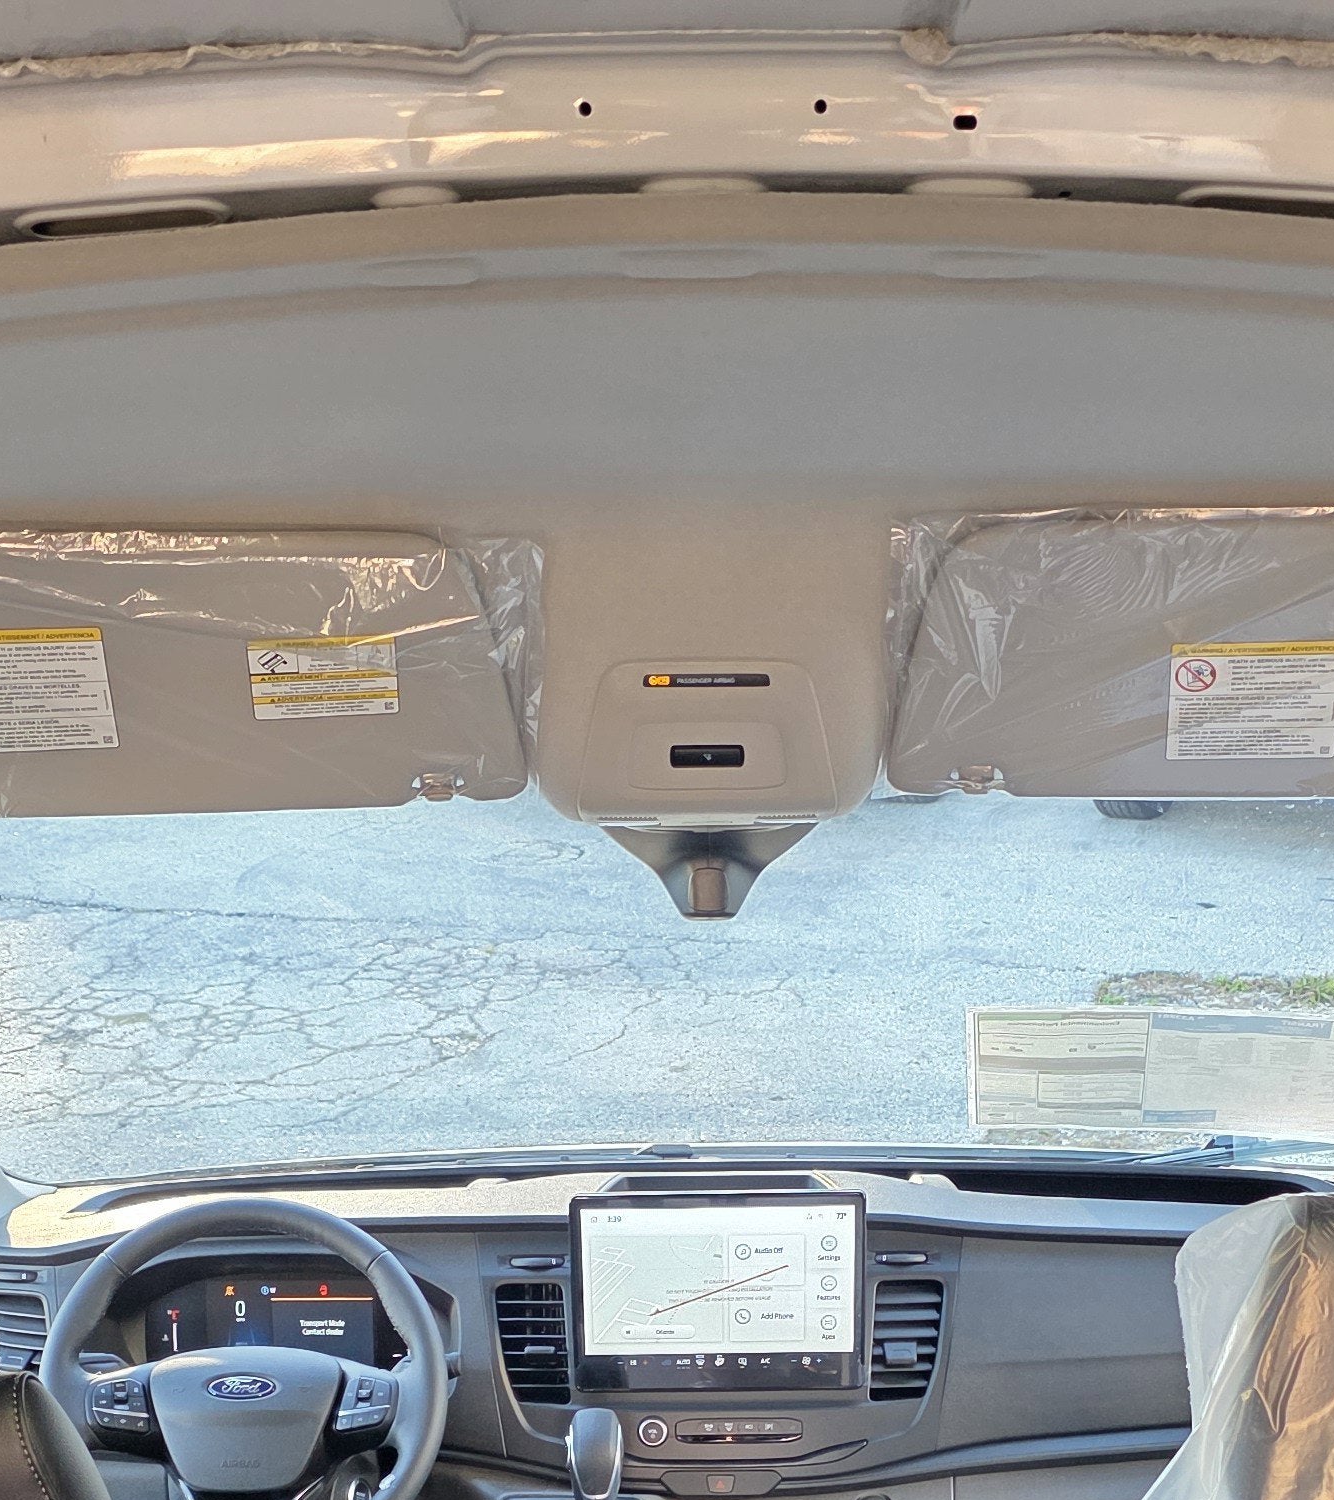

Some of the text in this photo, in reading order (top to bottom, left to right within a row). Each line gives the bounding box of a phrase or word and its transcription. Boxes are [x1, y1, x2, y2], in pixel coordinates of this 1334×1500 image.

[754, 1247, 772, 1255] Audio
[817, 1254, 841, 1262] Settings
[235, 1300, 246, 1317] 0
[760, 1312, 794, 1320] Add Phone
[299, 1319, 346, 1327] Transport Mode
[221, 1378, 262, 1394] Ford
[220, 1459, 261, 1469] AIRBAG
